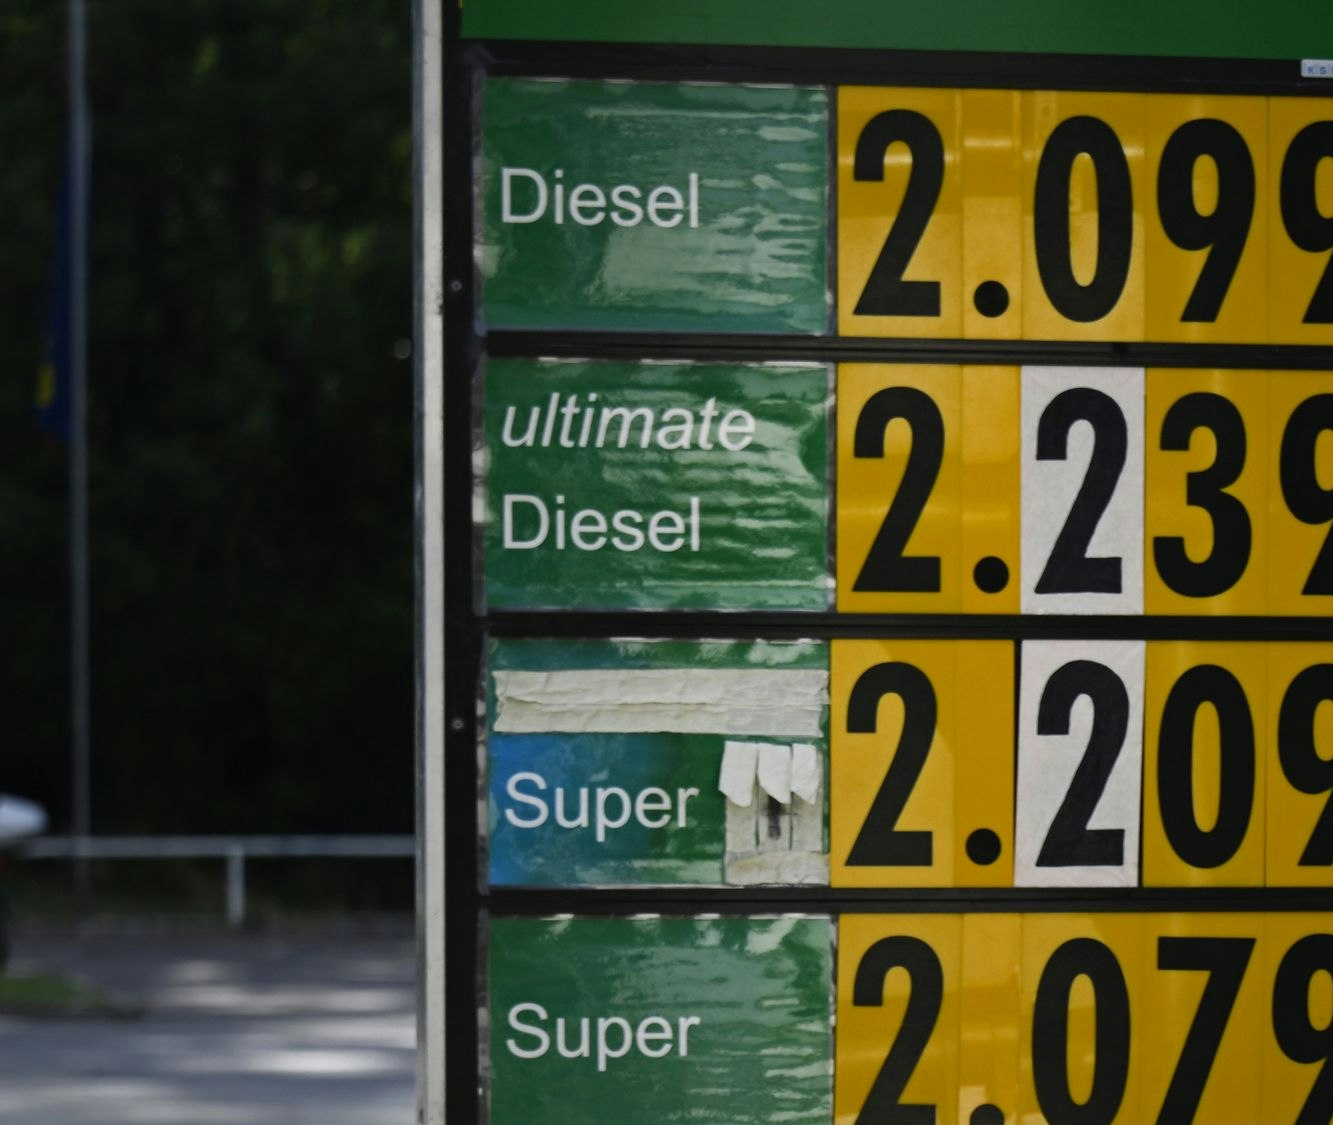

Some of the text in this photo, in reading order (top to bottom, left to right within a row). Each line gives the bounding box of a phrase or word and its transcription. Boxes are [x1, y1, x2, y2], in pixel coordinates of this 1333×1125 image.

[501, 167, 700, 229] Diesel
[502, 391, 756, 451] ultimate
[503, 493, 702, 553] Diesel
[504, 771, 700, 843] Super
[505, 1002, 702, 1073] Super
